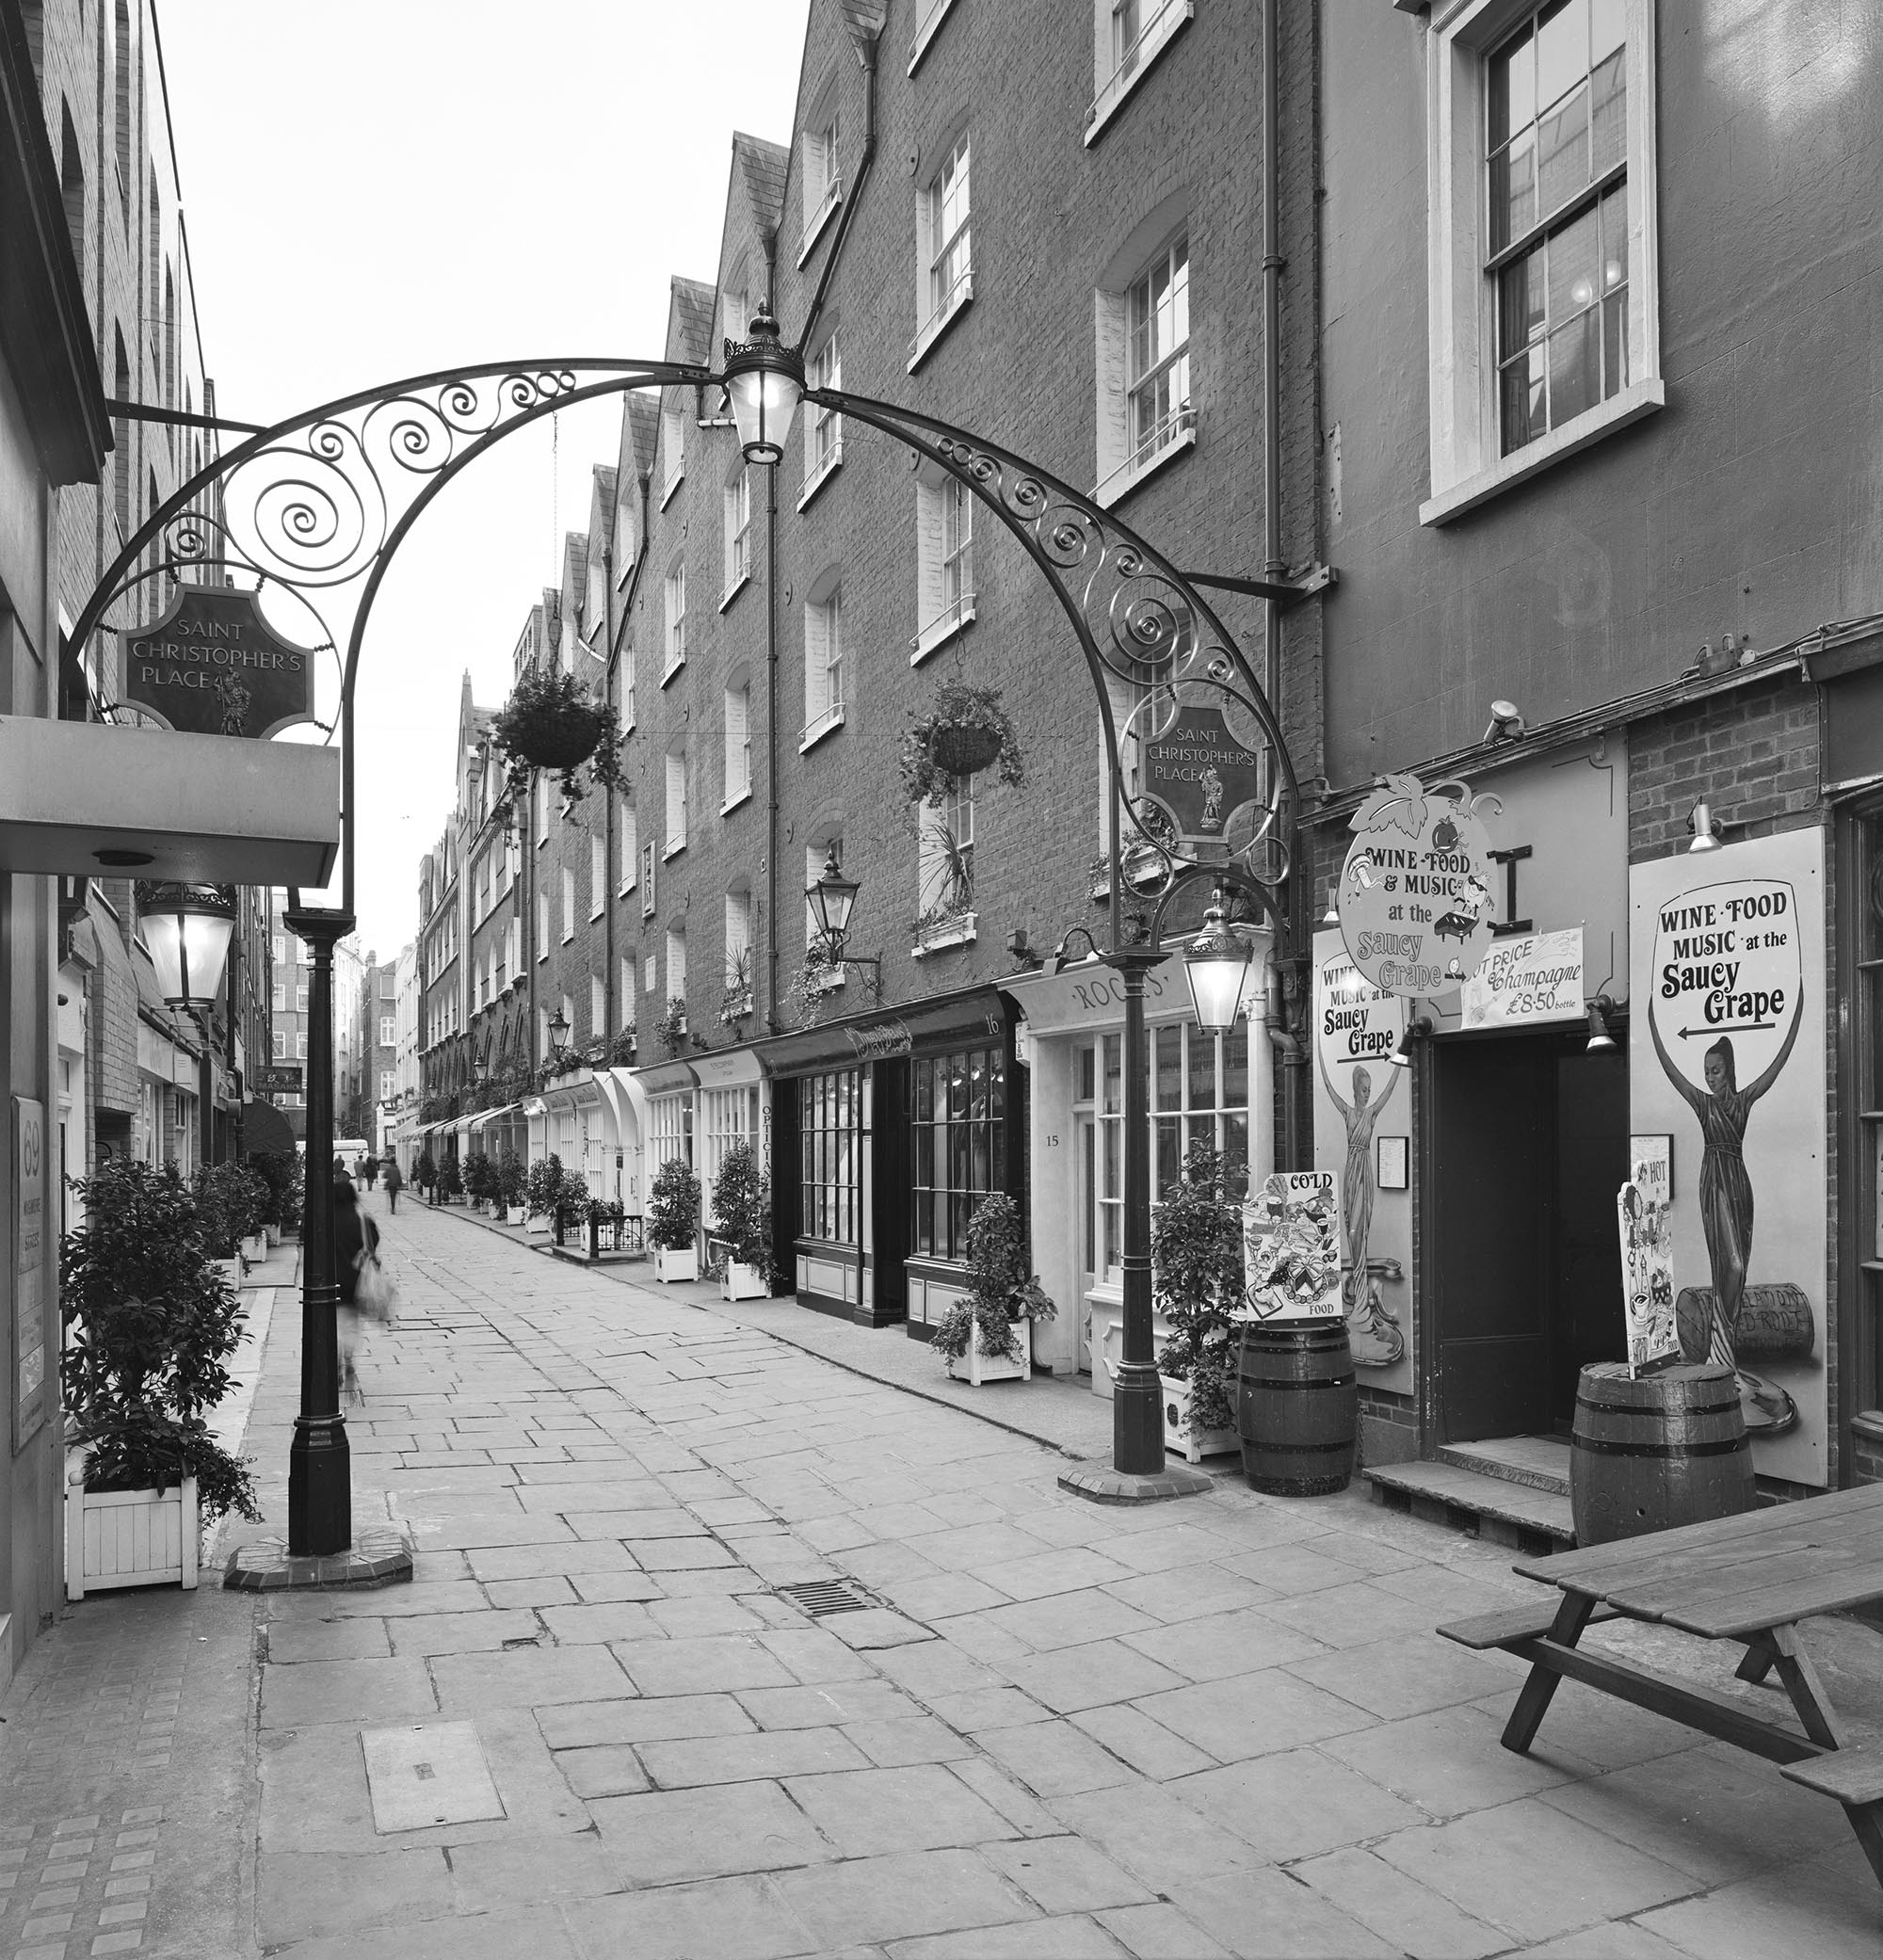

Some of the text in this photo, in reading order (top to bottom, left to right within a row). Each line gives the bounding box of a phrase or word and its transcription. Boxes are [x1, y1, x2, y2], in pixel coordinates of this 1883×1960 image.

[177, 619, 243, 641] SAINT
[132, 641, 301, 671] CHRISTOPHER'S
[141, 667, 210, 689] PLACE
[1176, 728, 1218, 743] SAINT
[1149, 747, 1255, 766] CHRISTOPHER'S
[1154, 765, 1198, 781] PLACE
[1384, 875, 1457, 895] & MUSIC
[1389, 904, 1432, 923] at the
[1661, 892, 1787, 933] WINE FOOD
[1358, 931, 1424, 962] Saucy
[1492, 940, 1534, 970] PRICE
[1673, 930, 1787, 960] MUSIC at the
[1379, 960, 1441, 991] Grape
[1488, 964, 1582, 991] Champagne
[1662, 961, 1740, 999] Saucy
[1330, 987, 1366, 1007] MUSIC
[1372, 989, 1379, 1001] at
[1554, 1000, 1576, 1009] bottle
[1704, 988, 1785, 1023] Grape
[985, 1012, 999, 1035] 16
[1324, 1008, 1370, 1036] Saucy
[1348, 1029, 1393, 1055] Grape
[24, 1119, 40, 1177] 69
[1047, 1135, 1059, 1147] 15
[1291, 1173, 1333, 1190] COLD
[1650, 1160, 1666, 1183] HOT
[1310, 1304, 1334, 1315] FOOD
[1667, 1339, 1678, 1353] FOOD
